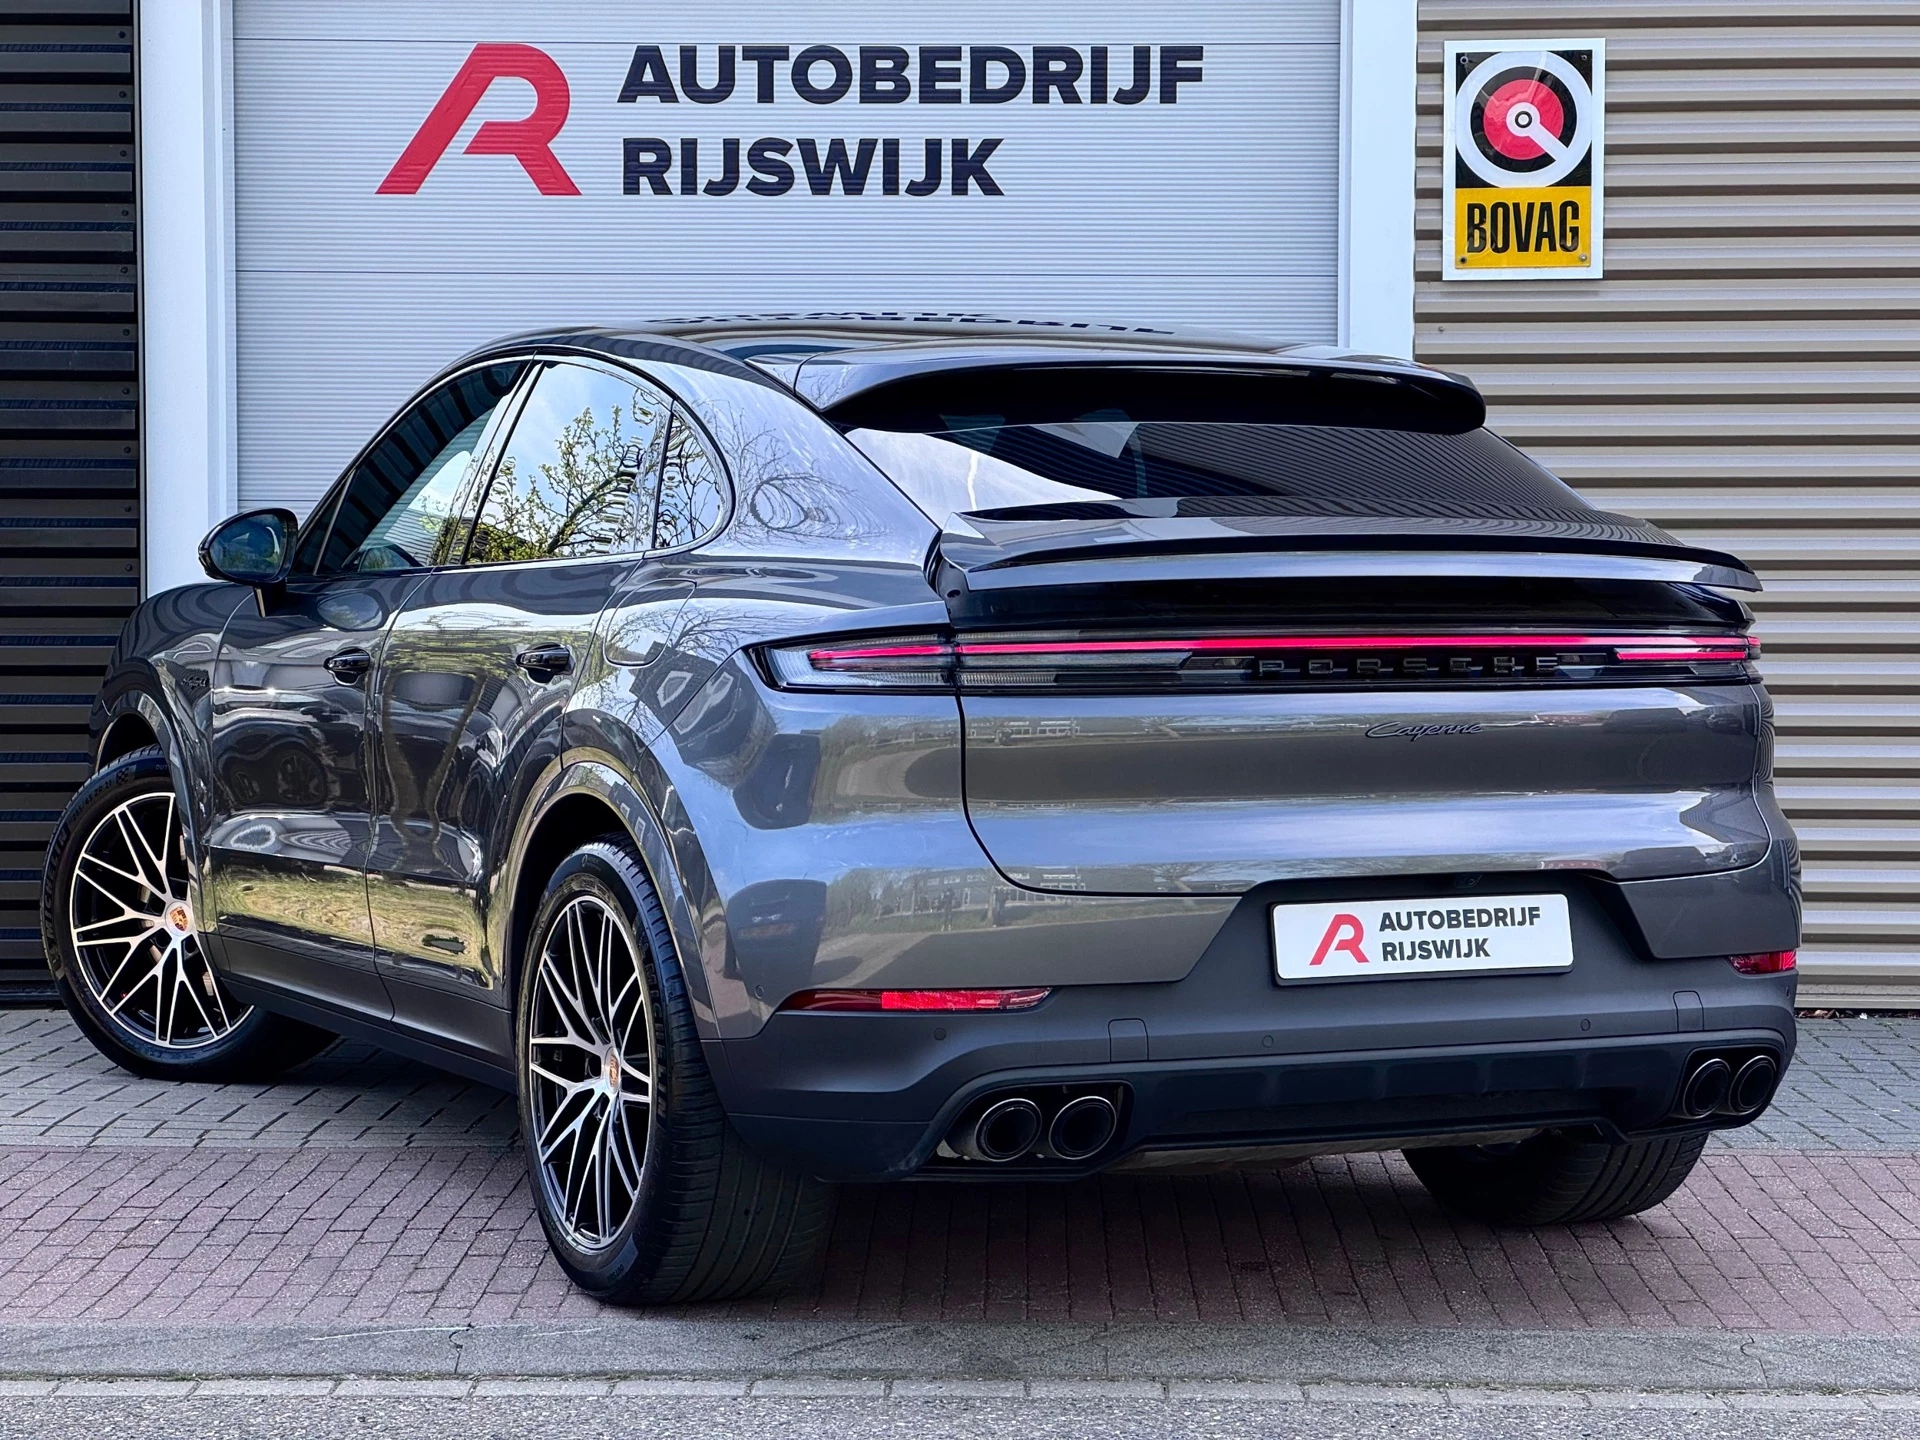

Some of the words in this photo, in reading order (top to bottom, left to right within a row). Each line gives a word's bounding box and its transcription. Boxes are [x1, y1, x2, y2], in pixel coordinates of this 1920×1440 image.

[617, 45, 1205, 105] AUTOBEDRIJF
[622, 137, 1005, 197] RIJSWIJK
[1466, 200, 1580, 254] BOVAG
[1258, 655, 1559, 677] PORSCHE
[1365, 720, 1484, 742] Cayenne
[44, 826, 69, 941] MICHELIN
[1378, 906, 1541, 932] AUTOBEDRIJF
[1381, 937, 1491, 962] RIJSWIJK
[644, 962, 669, 1119] MICHELIN
